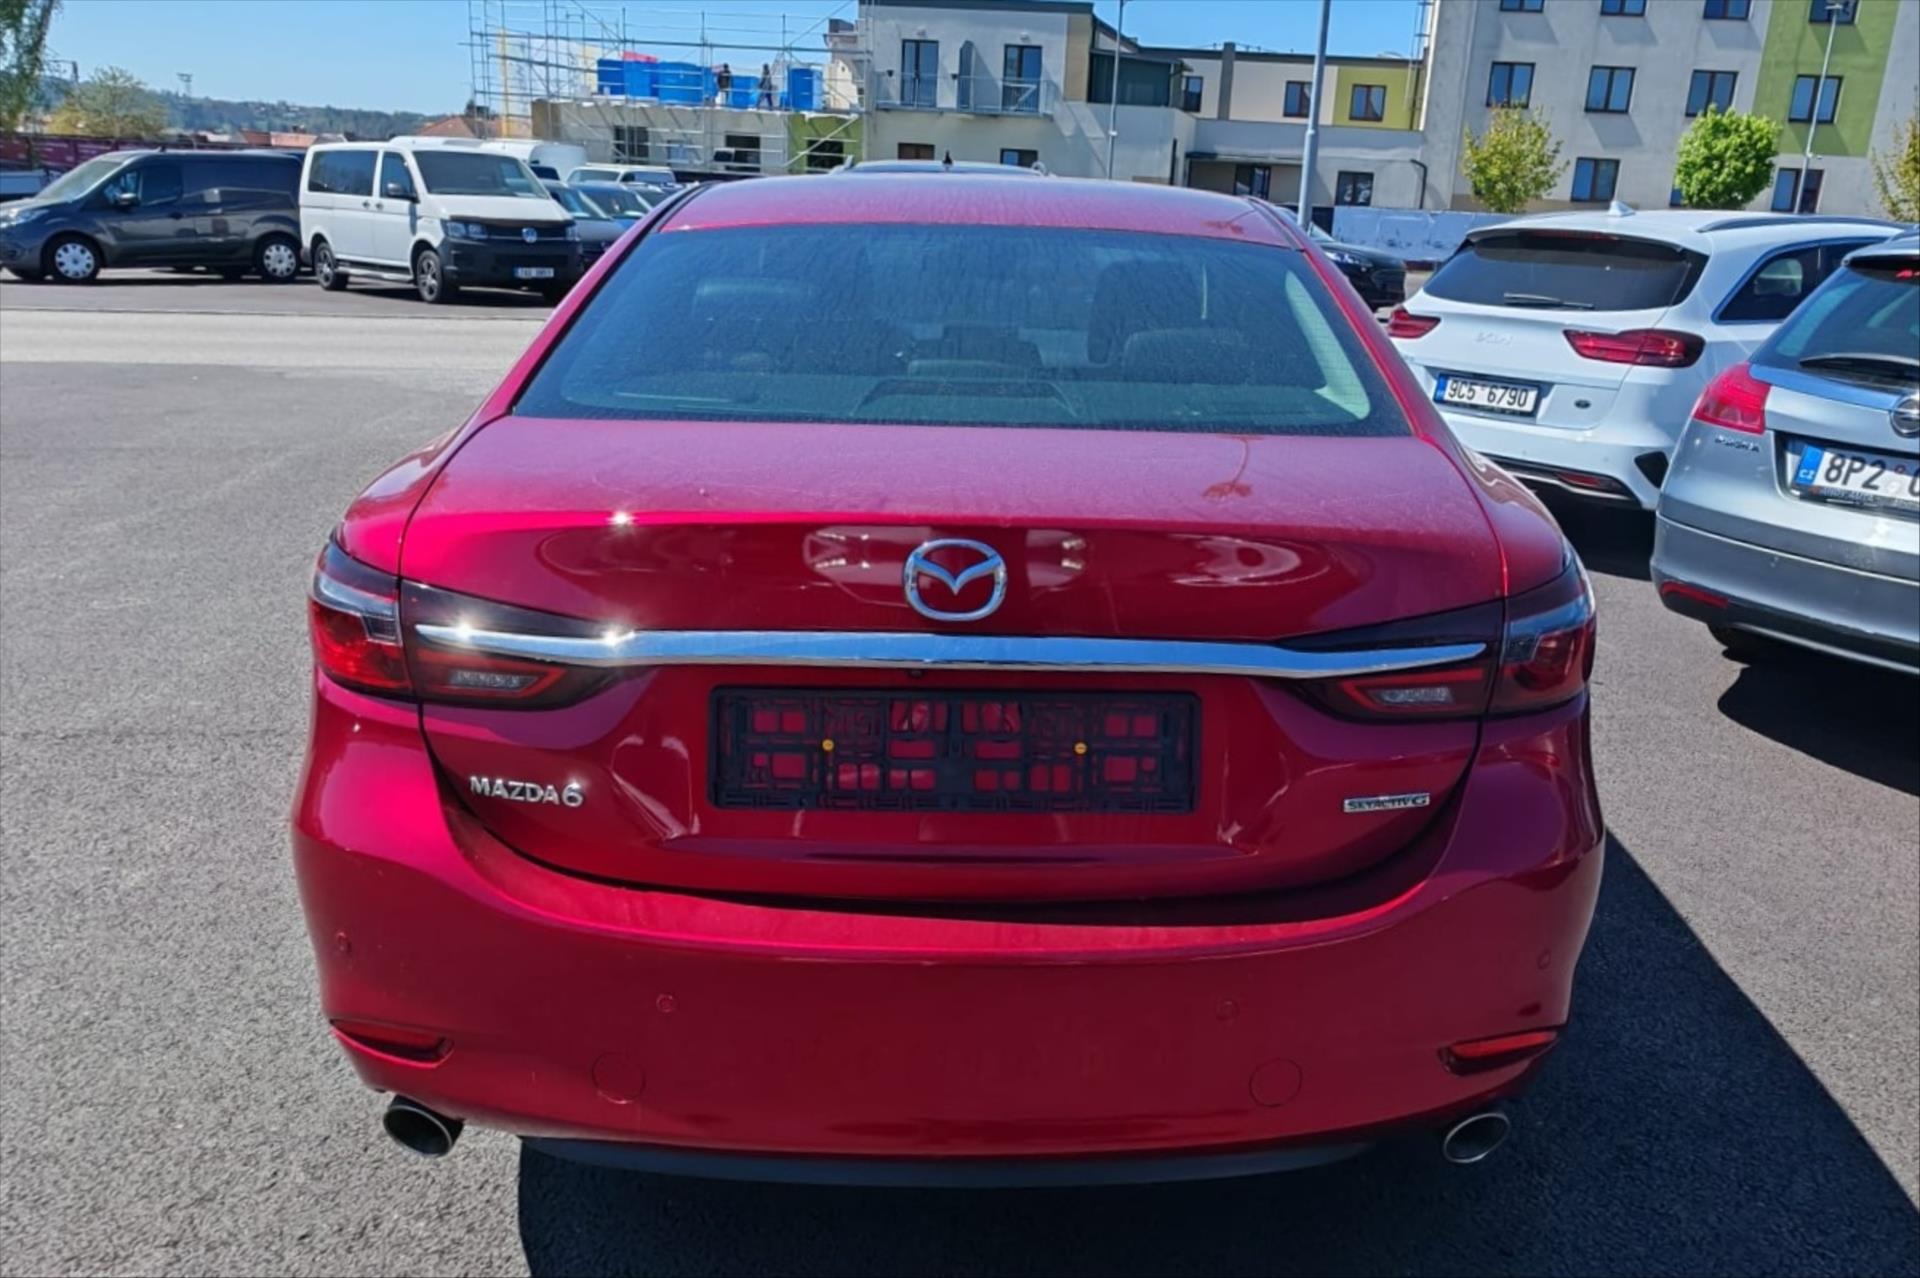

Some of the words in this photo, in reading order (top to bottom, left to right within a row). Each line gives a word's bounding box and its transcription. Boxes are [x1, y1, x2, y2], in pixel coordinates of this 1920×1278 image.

[1447, 379, 1476, 401] 9C5
[1487, 384, 1529, 408] 6790
[1824, 452, 1887, 490] 8P2
